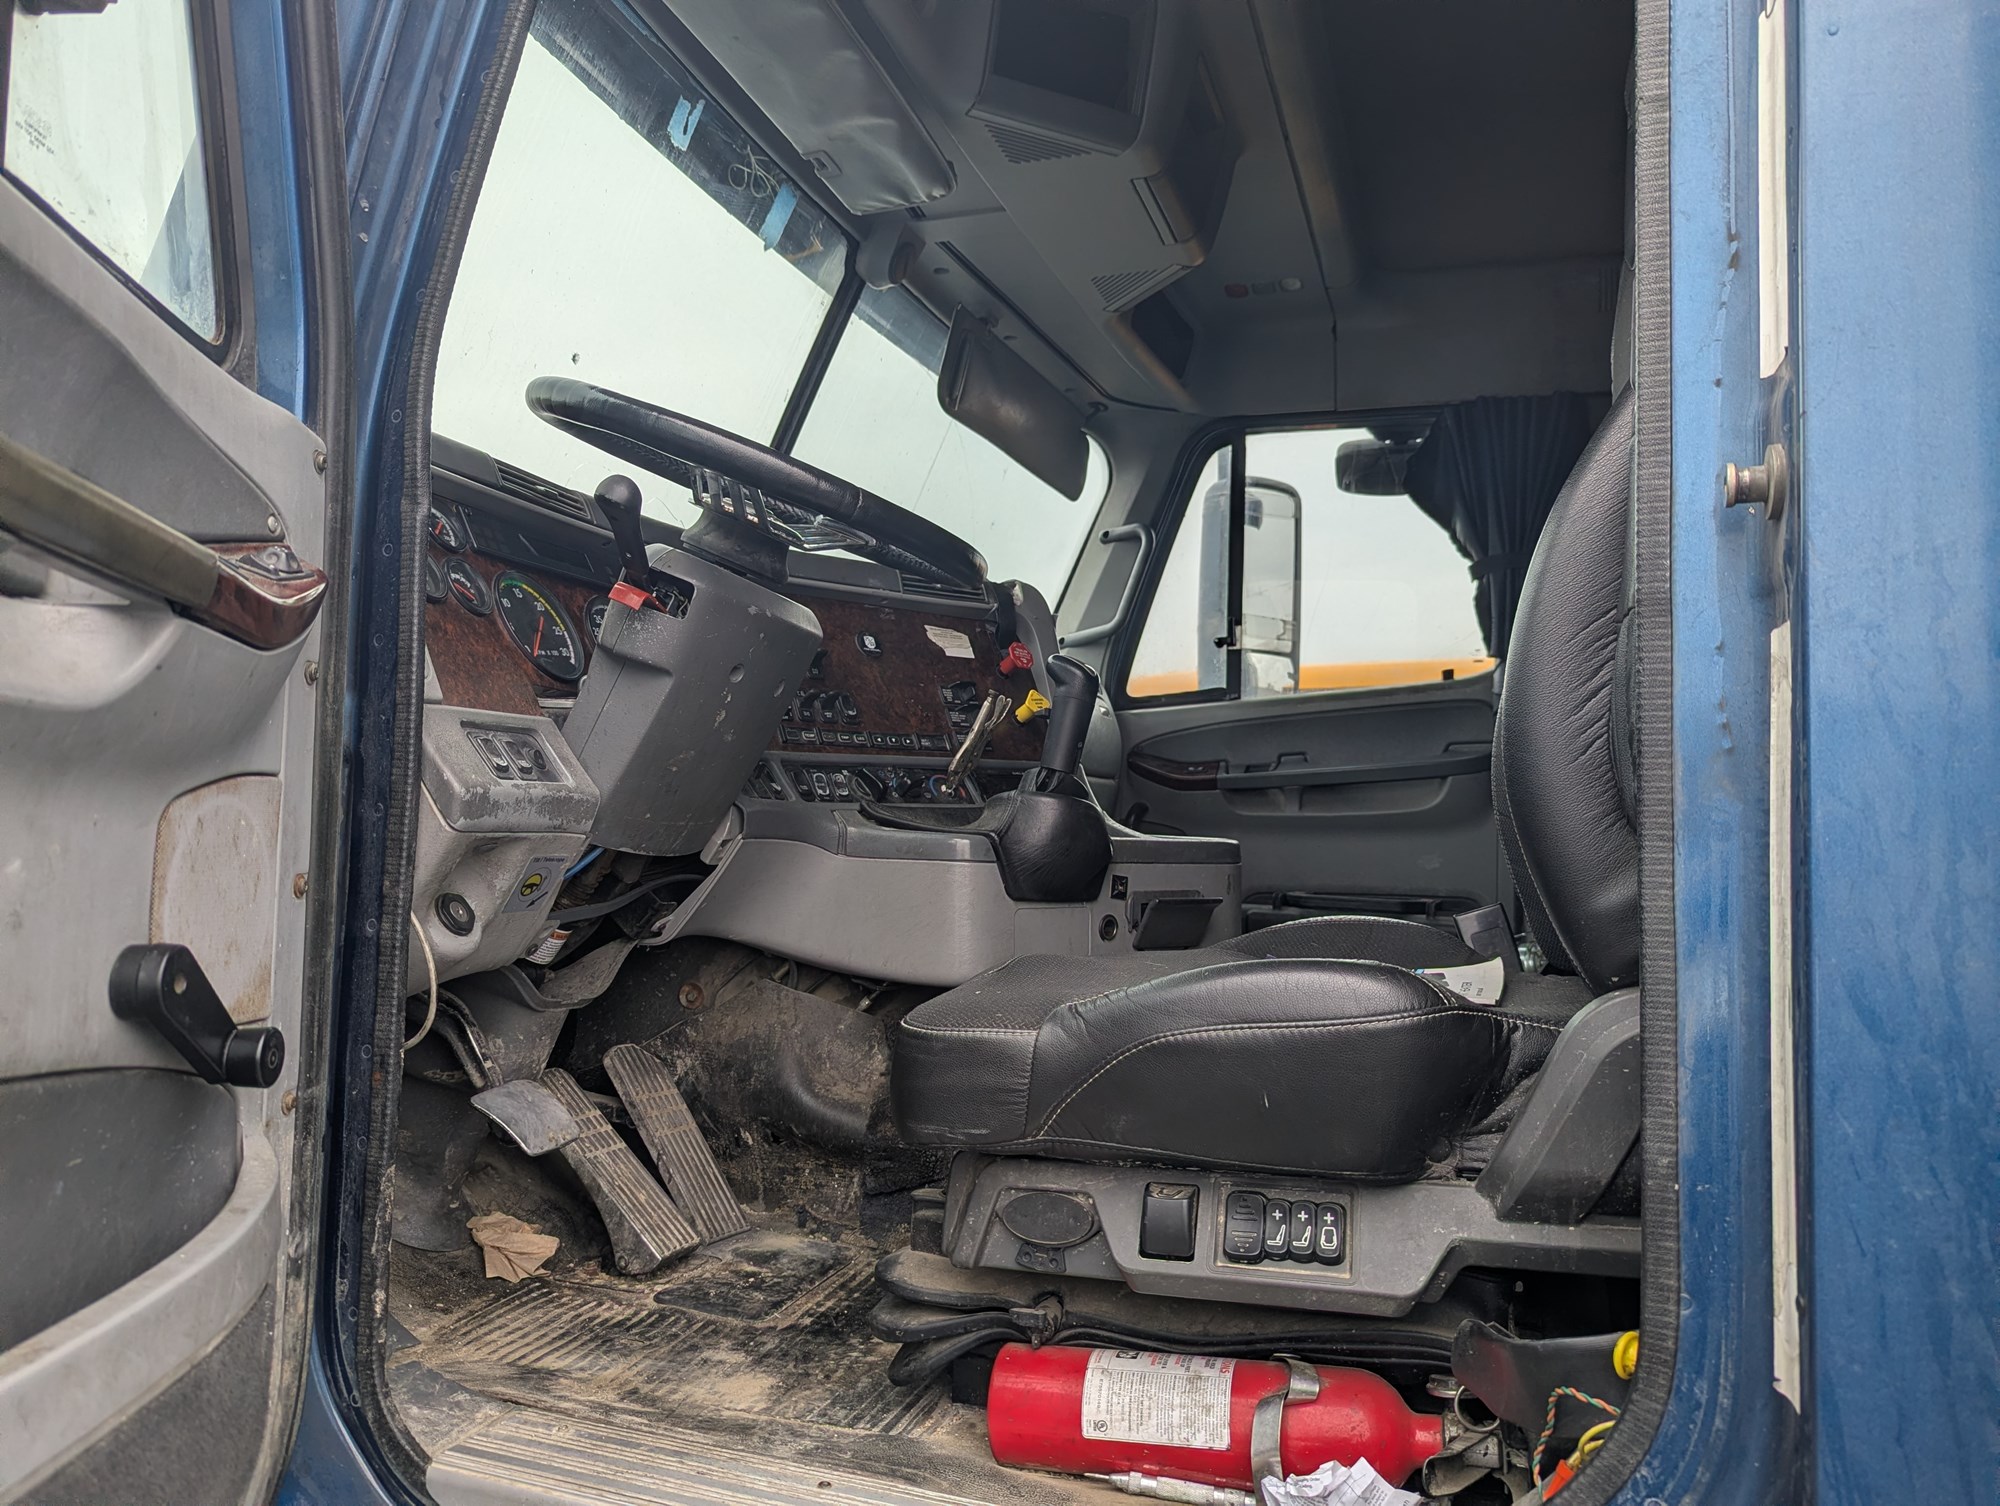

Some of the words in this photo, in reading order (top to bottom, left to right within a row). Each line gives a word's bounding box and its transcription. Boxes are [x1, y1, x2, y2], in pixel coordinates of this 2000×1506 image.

[512, 588, 523, 598] 15
[501, 598, 511, 608] 10
[534, 602, 545, 611] 20
[552, 626, 563, 635] 25
[560, 647, 571, 657] 30
